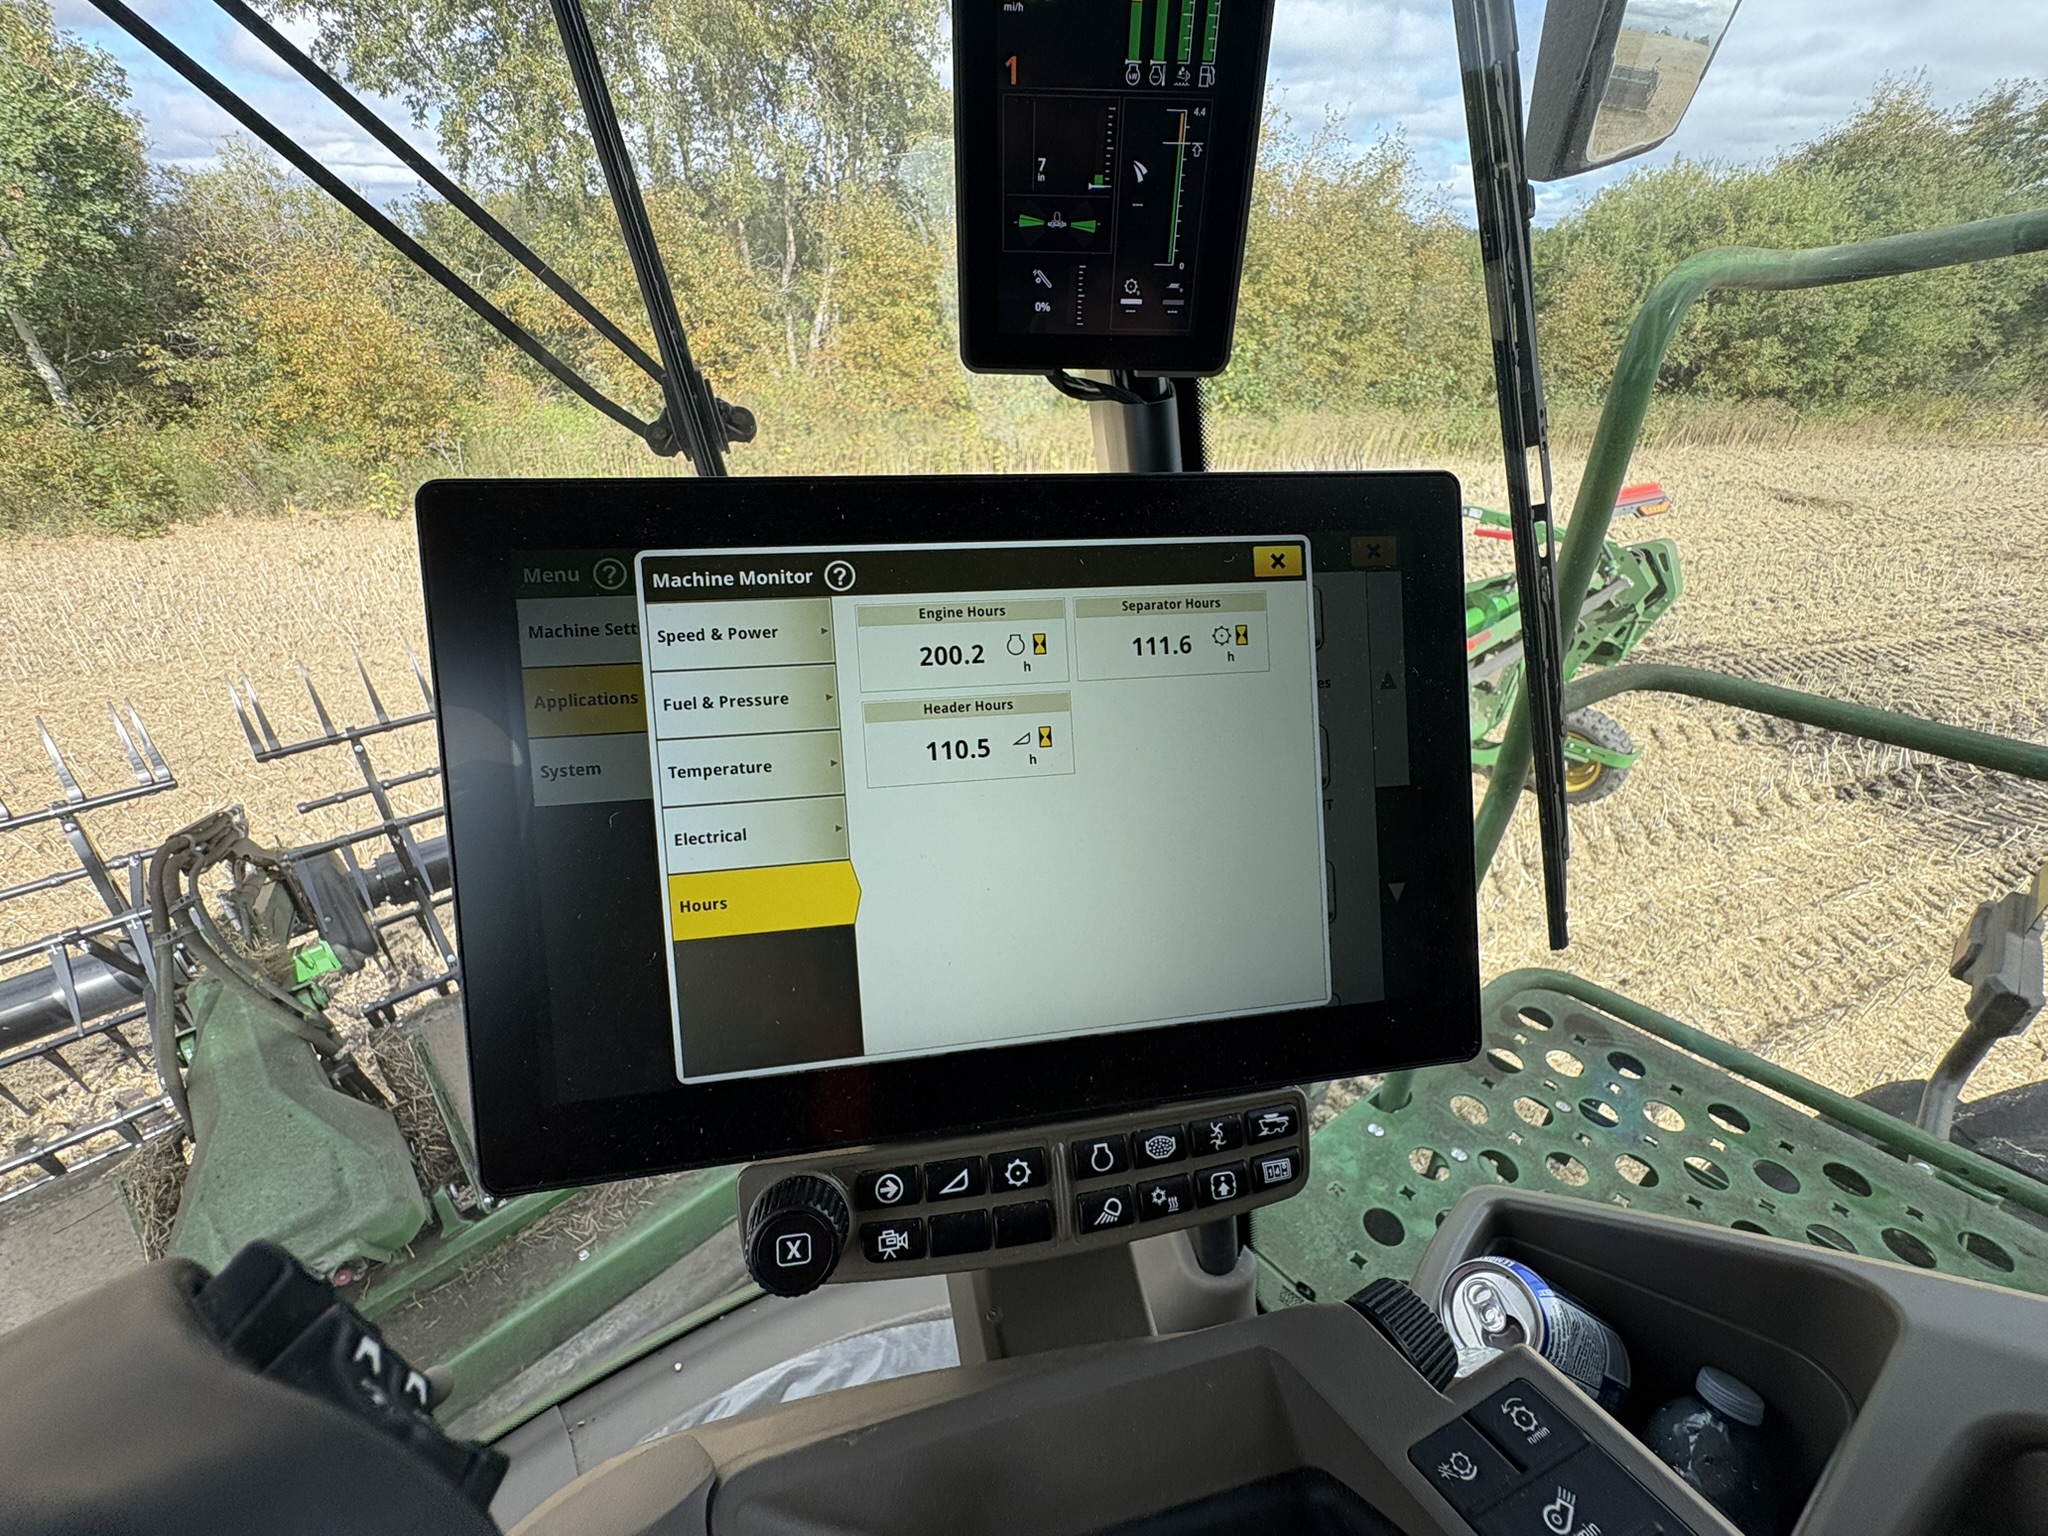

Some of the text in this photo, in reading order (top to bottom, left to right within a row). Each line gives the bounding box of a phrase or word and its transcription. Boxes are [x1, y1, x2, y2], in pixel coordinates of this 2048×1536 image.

[1005, 55, 1018, 86] 1
[1193, 107, 1207, 117] 4.4
[1037, 157, 1047, 172] 7
[1037, 172, 1046, 182] in
[1178, 262, 1185, 271] 0
[1034, 302, 1051, 313] 0%
[523, 567, 580, 584] Menu
[652, 571, 735, 589] Machine
[739, 568, 813, 587] Monitor
[918, 602, 1006, 621] Engine Hours
[1121, 596, 1222, 614] Separator Hours
[528, 621, 638, 639] Machine Sett
[657, 626, 778, 647] Speed & Power
[919, 643, 985, 667] 200.2
[1132, 634, 1193, 658] 111.6
[1227, 651, 1235, 663] h
[1023, 661, 1032, 673] h
[534, 690, 639, 711] Applications
[663, 693, 790, 711] Fuel & Pressure
[923, 698, 1014, 716] Header Hours
[926, 736, 992, 762] 110.5
[1029, 754, 1037, 766] h
[540, 763, 602, 780] System
[668, 761, 773, 781] Temperature
[674, 828, 748, 847] Electrical
[680, 899, 728, 914] Hours
[1527, 1426, 1551, 1446] n/min
